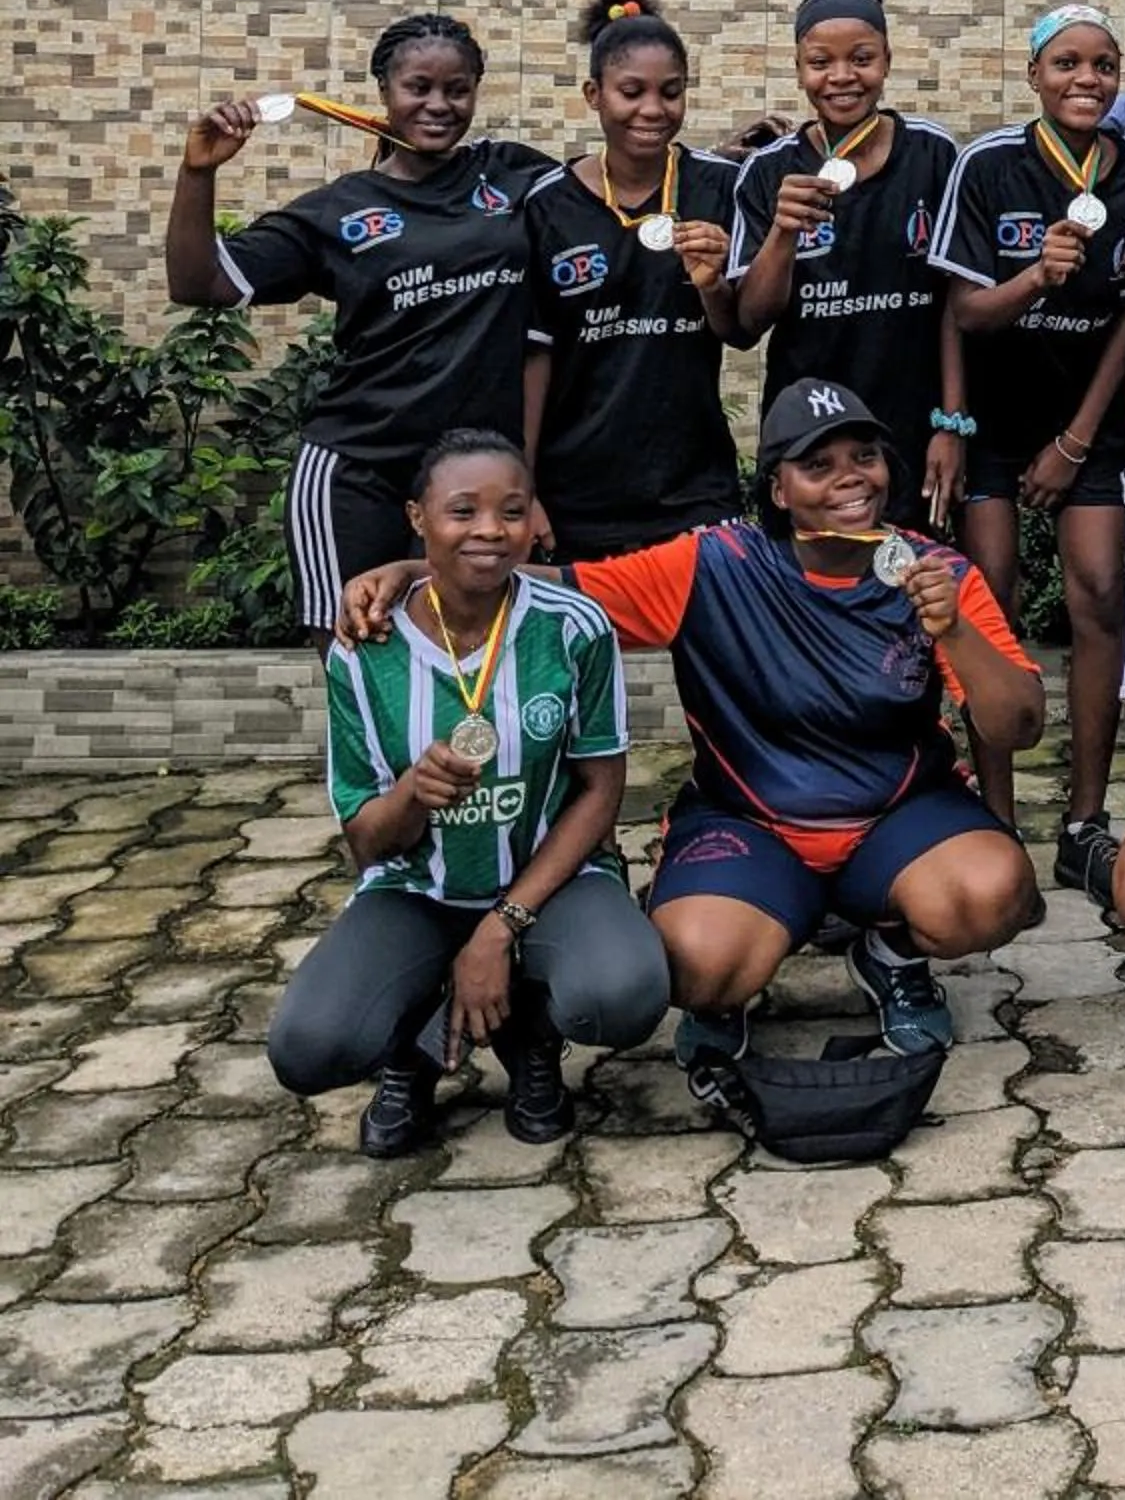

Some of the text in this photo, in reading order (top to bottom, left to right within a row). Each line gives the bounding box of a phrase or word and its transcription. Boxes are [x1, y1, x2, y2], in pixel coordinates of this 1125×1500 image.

[341, 212, 405, 242] OPS
[797, 221, 836, 248] PS
[997, 221, 1046, 249] OPS
[386, 265, 434, 291] OUM
[552, 252, 609, 286] OPS
[393, 270, 496, 311] PRESSING
[800, 280, 849, 299] OUM
[585, 304, 621, 325] UM
[800, 293, 903, 319] PRESSING
[807, 386, 846, 418] NY
